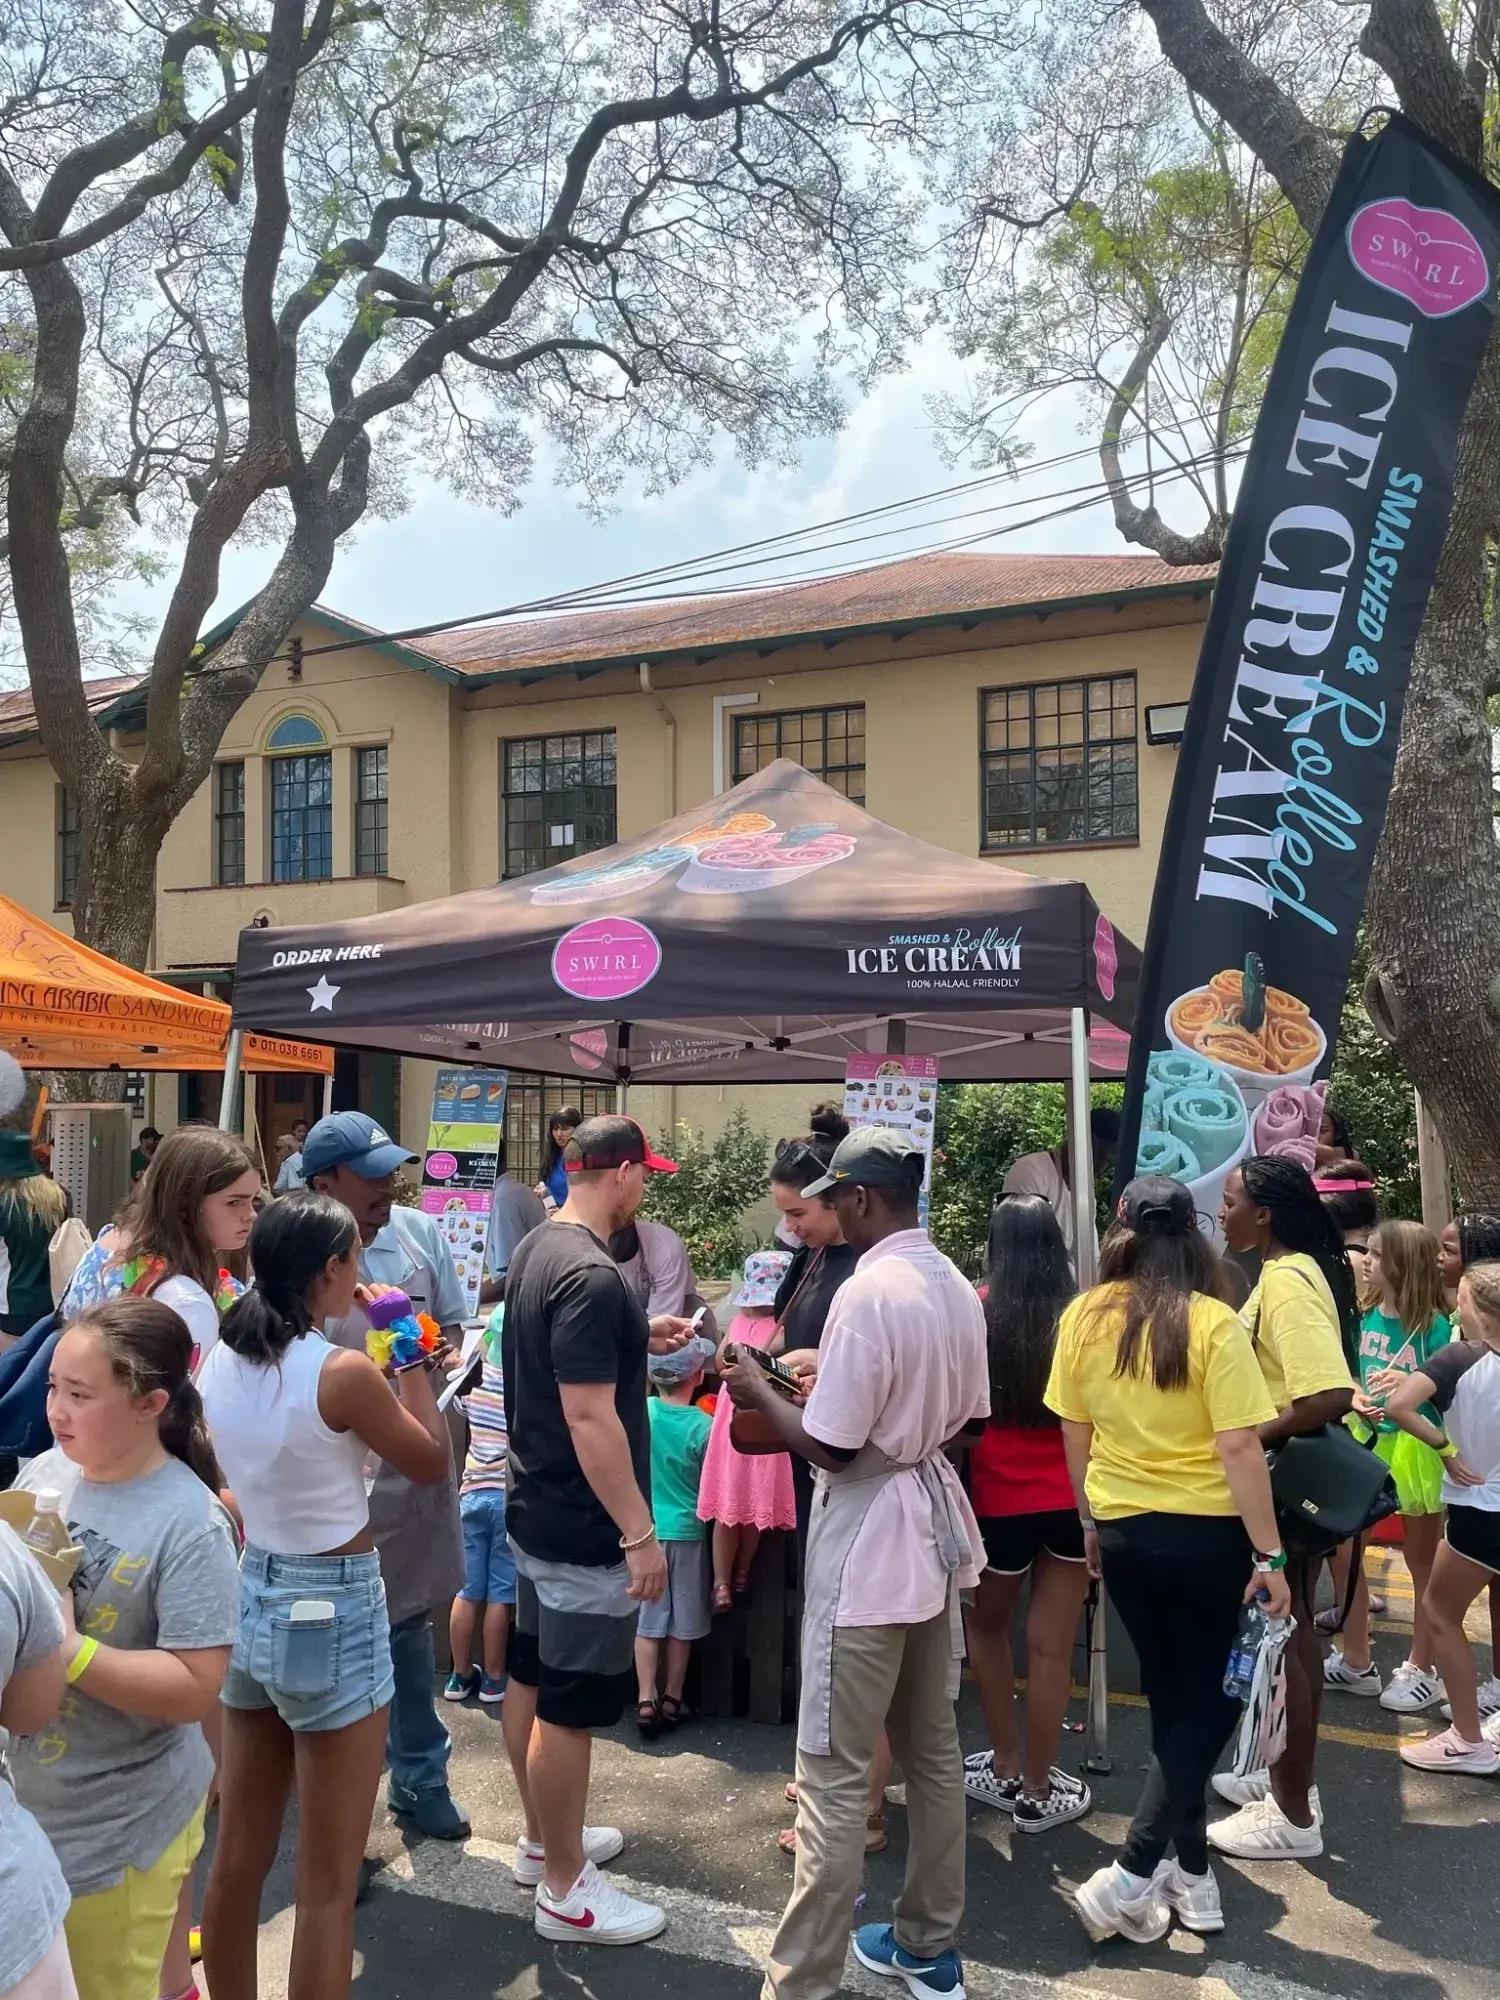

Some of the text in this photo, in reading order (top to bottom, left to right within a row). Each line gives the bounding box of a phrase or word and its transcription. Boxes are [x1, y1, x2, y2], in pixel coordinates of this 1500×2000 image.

[1368, 233, 1465, 285] SWIRL
[1195, 299, 1415, 921] ICE CREAM
[1266, 466, 1424, 936] SMASHED & Rolled
[888, 926, 1023, 951] SMASHED & Rolled
[272, 943, 384, 968] ORDER HERE
[569, 954, 642, 973] SWIRL
[847, 945, 1022, 974] ICE CREAM
[906, 978, 1020, 989] 100% HALAAL FRIENDLY
[43, 986, 117, 1015] ARABIC
[118, 995, 225, 1031] SANDWICH
[97, 1021, 155, 1035] ARABIC
[260, 1039, 322, 1060] 011 038 6661
